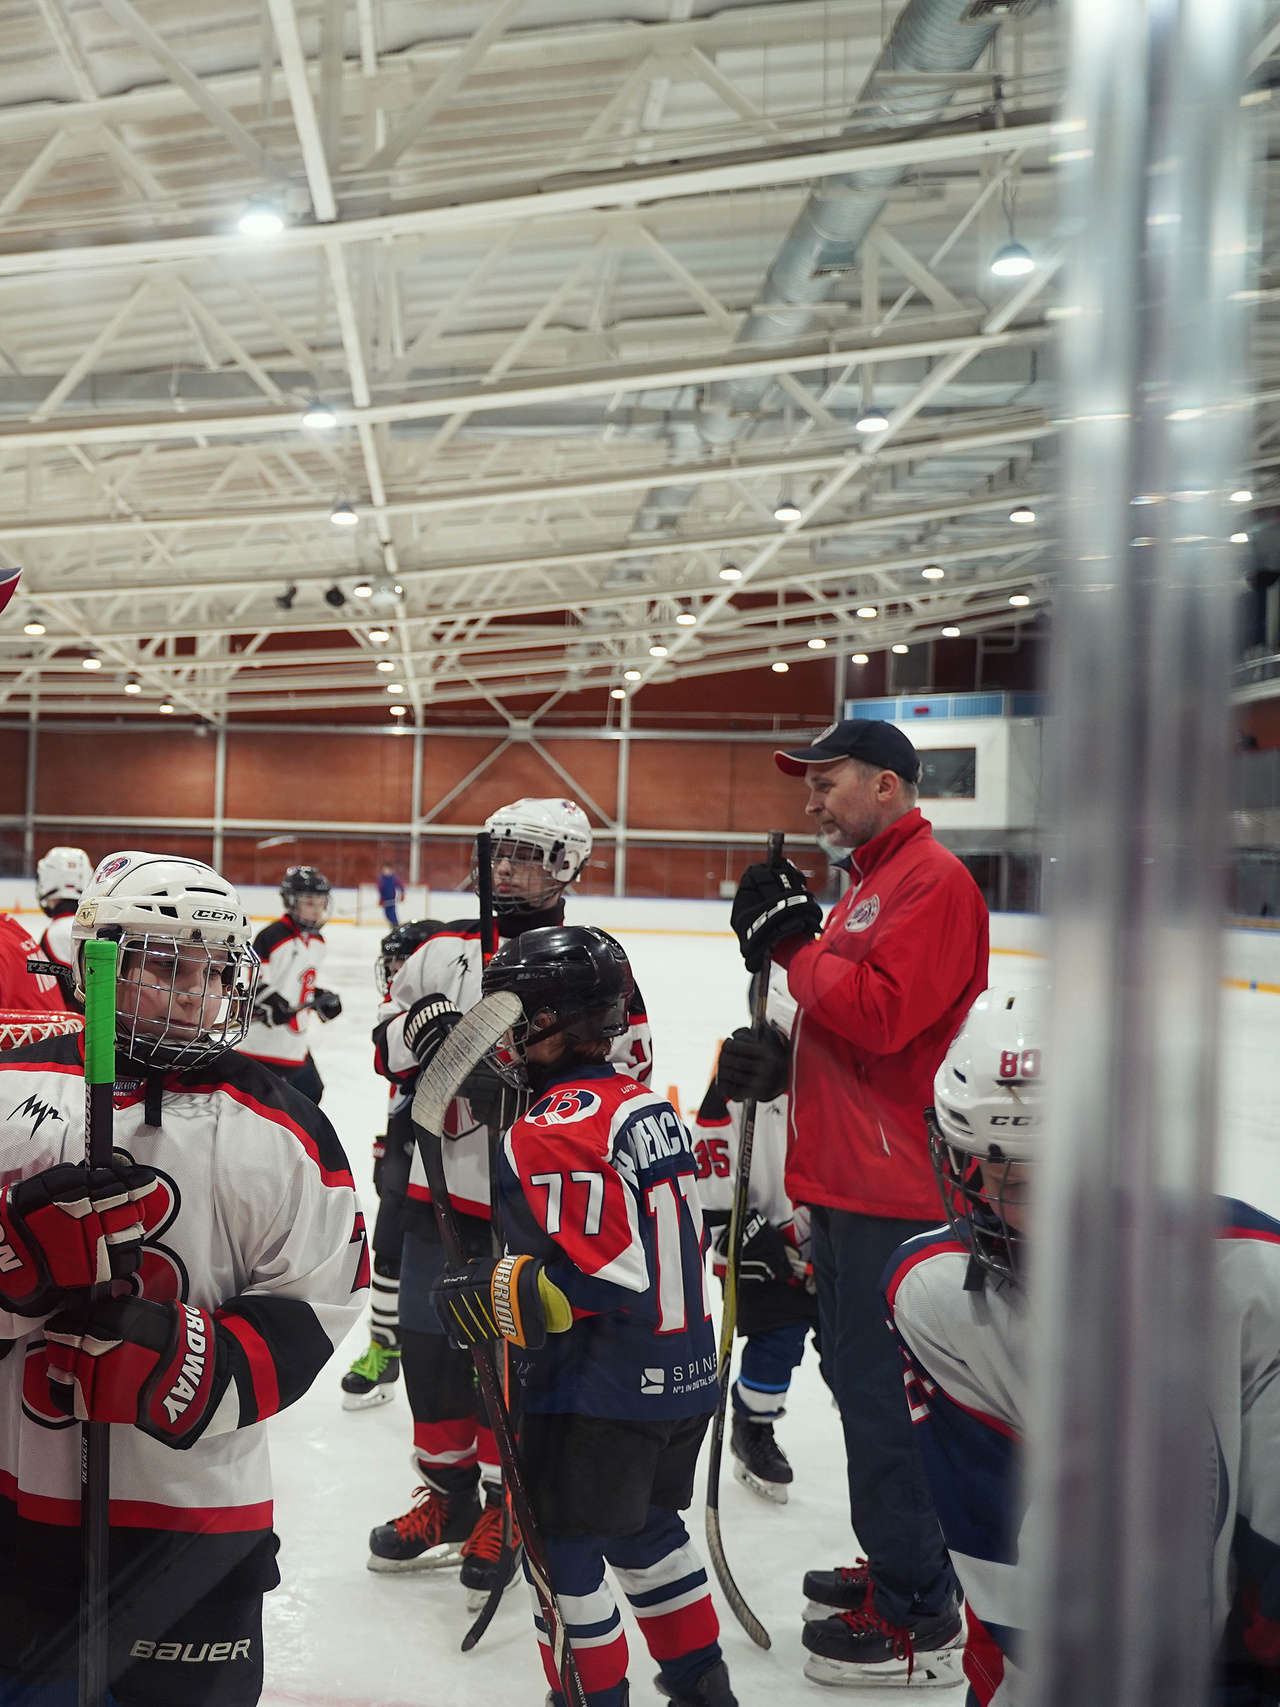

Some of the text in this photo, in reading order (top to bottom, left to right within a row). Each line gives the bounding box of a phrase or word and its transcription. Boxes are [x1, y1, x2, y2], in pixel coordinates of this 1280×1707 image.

[196, 909, 237, 922] CCM
[533, 1088, 583, 1127] B
[989, 1114, 1043, 1127] CC
[742, 1120, 755, 1178] BAUER
[530, 1170, 604, 1236] 77
[129, 1638, 252, 1663] BAUER
